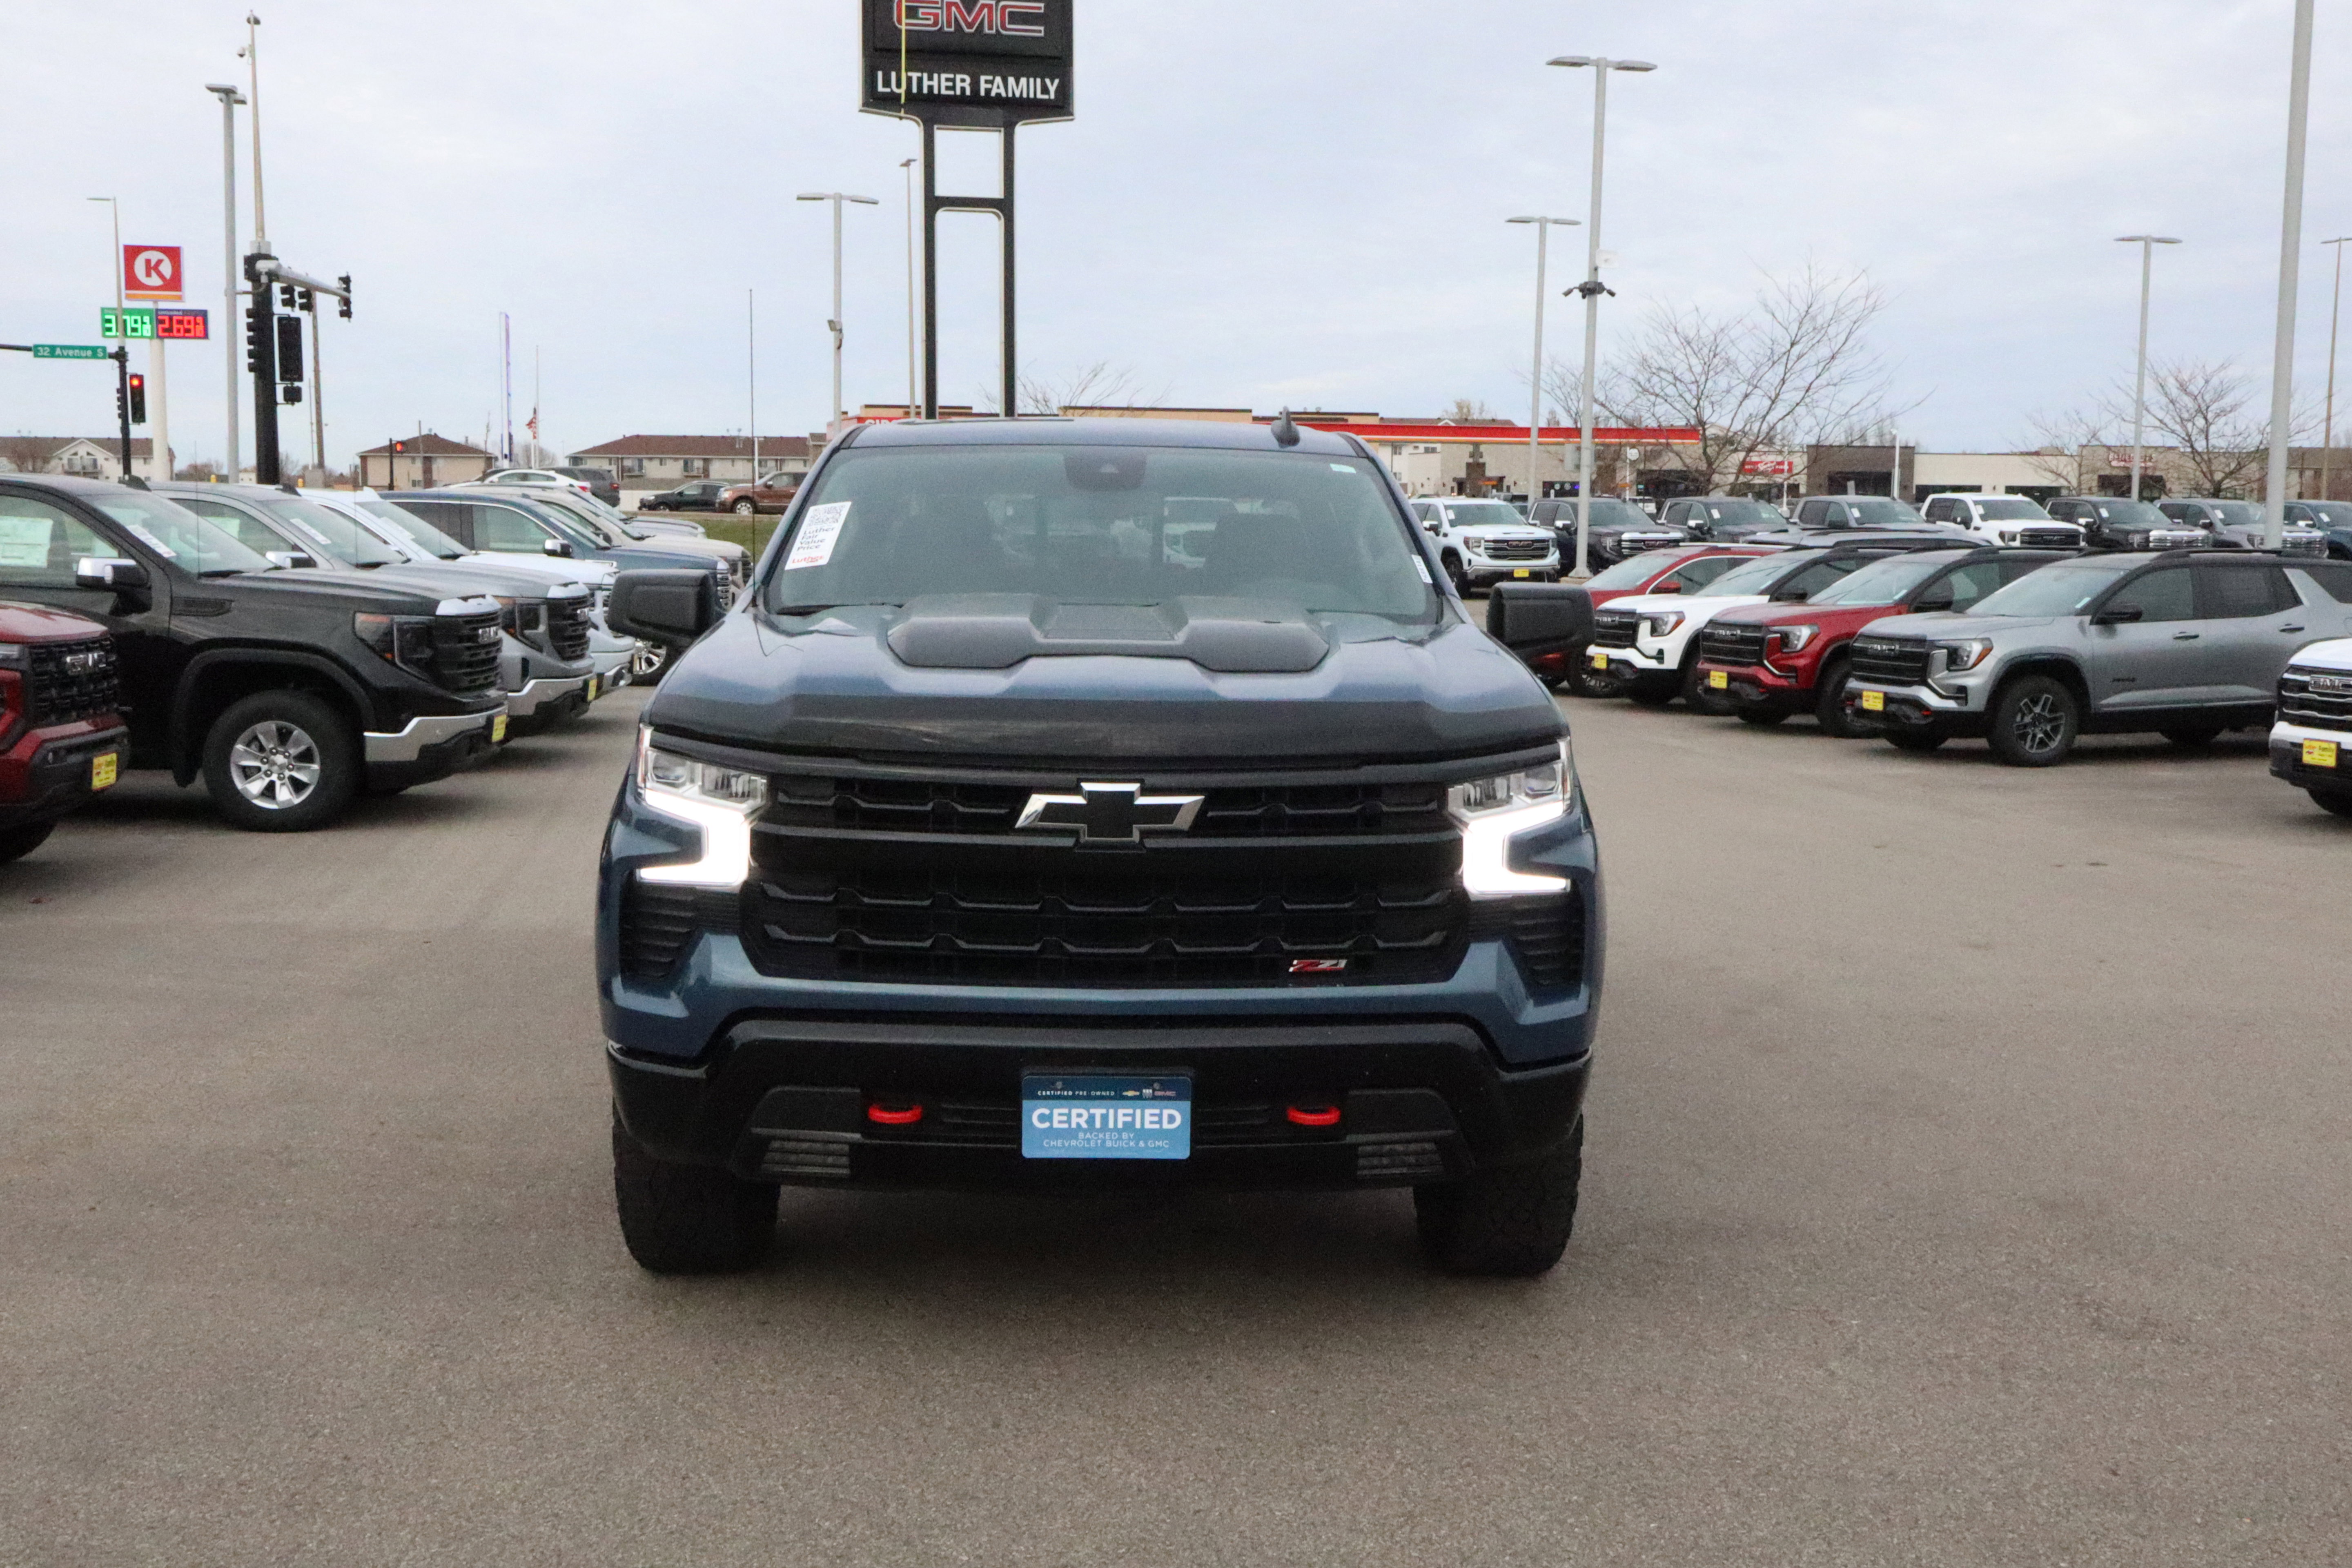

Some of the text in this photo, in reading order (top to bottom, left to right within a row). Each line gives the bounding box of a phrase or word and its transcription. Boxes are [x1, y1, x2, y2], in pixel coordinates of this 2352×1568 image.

[893, 0, 1045, 37] GMC
[877, 71, 1060, 100] LUTHER FAMILY
[145, 258, 168, 284] K
[37, 347, 104, 357] 32 Avenue S
[803, 527, 835, 535] Luther
[2310, 676, 2352, 693] GMC
[1288, 959, 1348, 972] Z71
[1031, 1108, 1181, 1129] CERTIFIED
